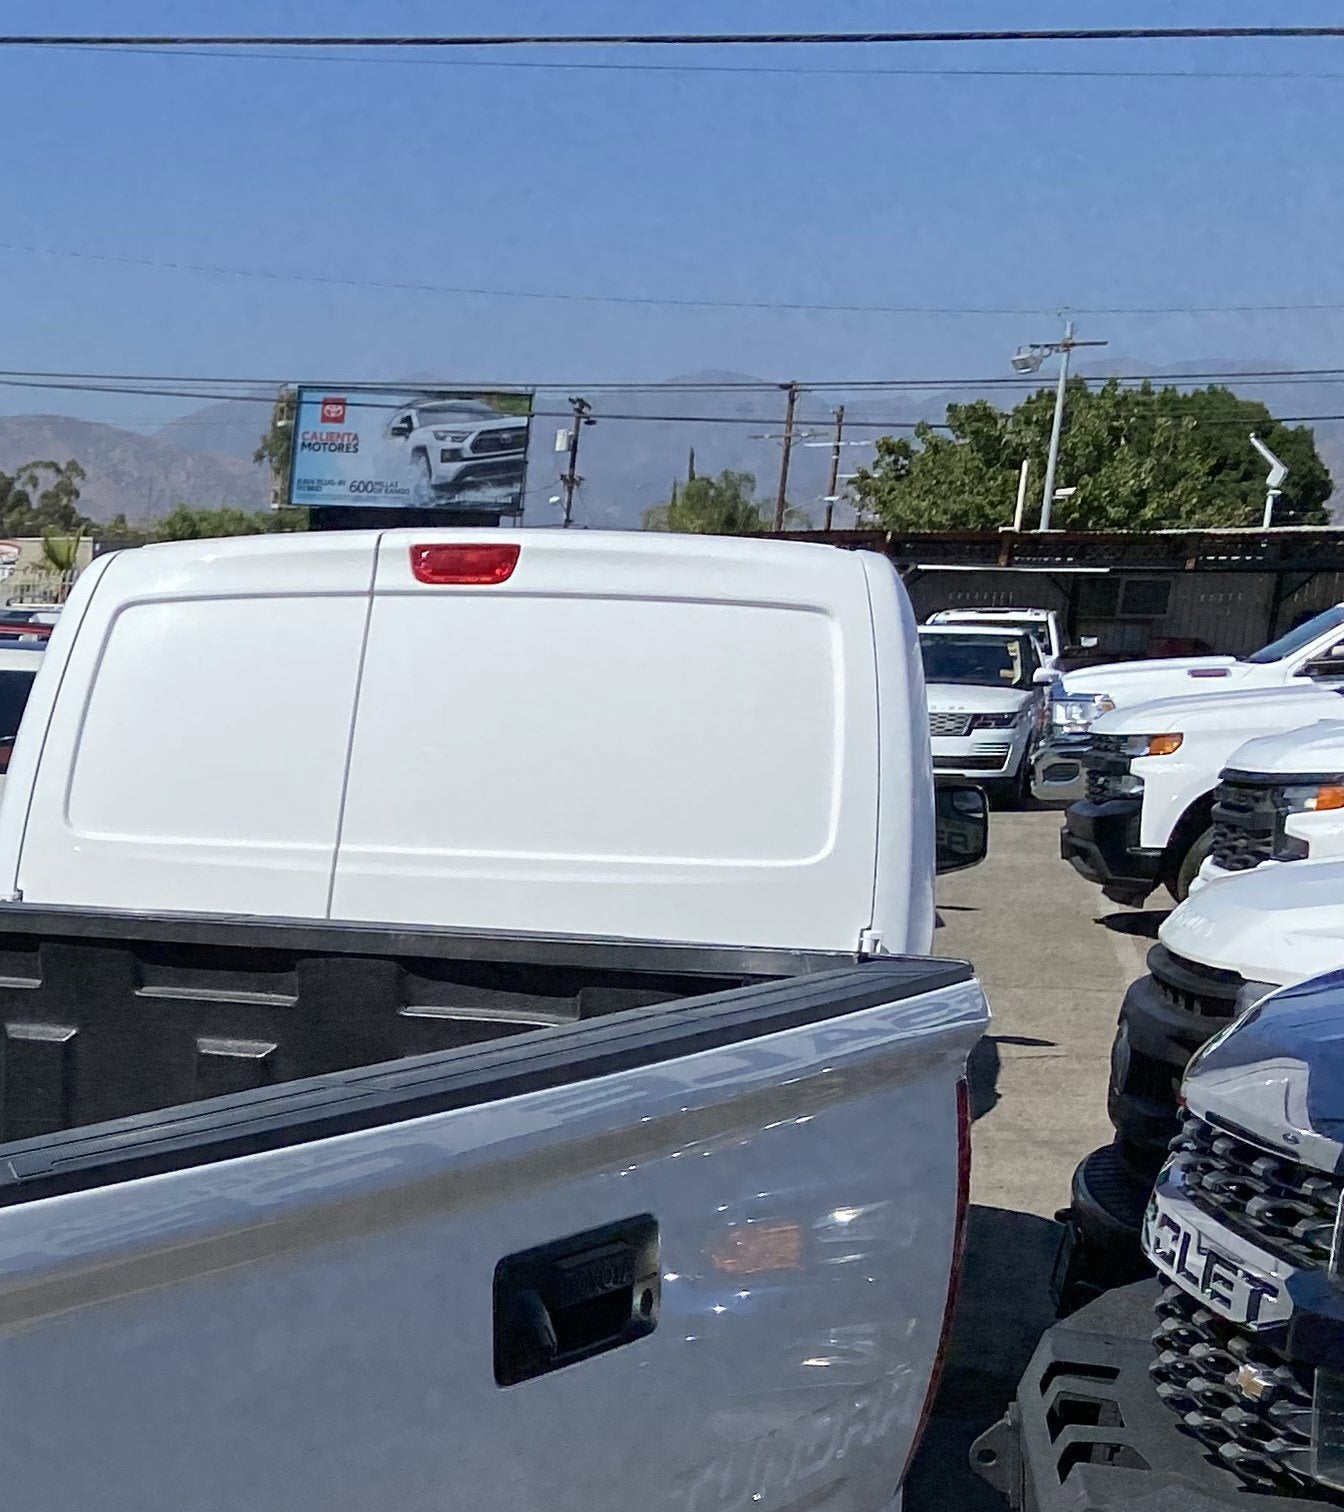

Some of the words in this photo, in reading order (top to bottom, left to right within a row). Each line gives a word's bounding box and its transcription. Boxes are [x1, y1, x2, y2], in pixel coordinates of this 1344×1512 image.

[301, 431, 359, 442] CALIENTA
[300, 442, 359, 453] MOTORES
[349, 480, 373, 493] 600
